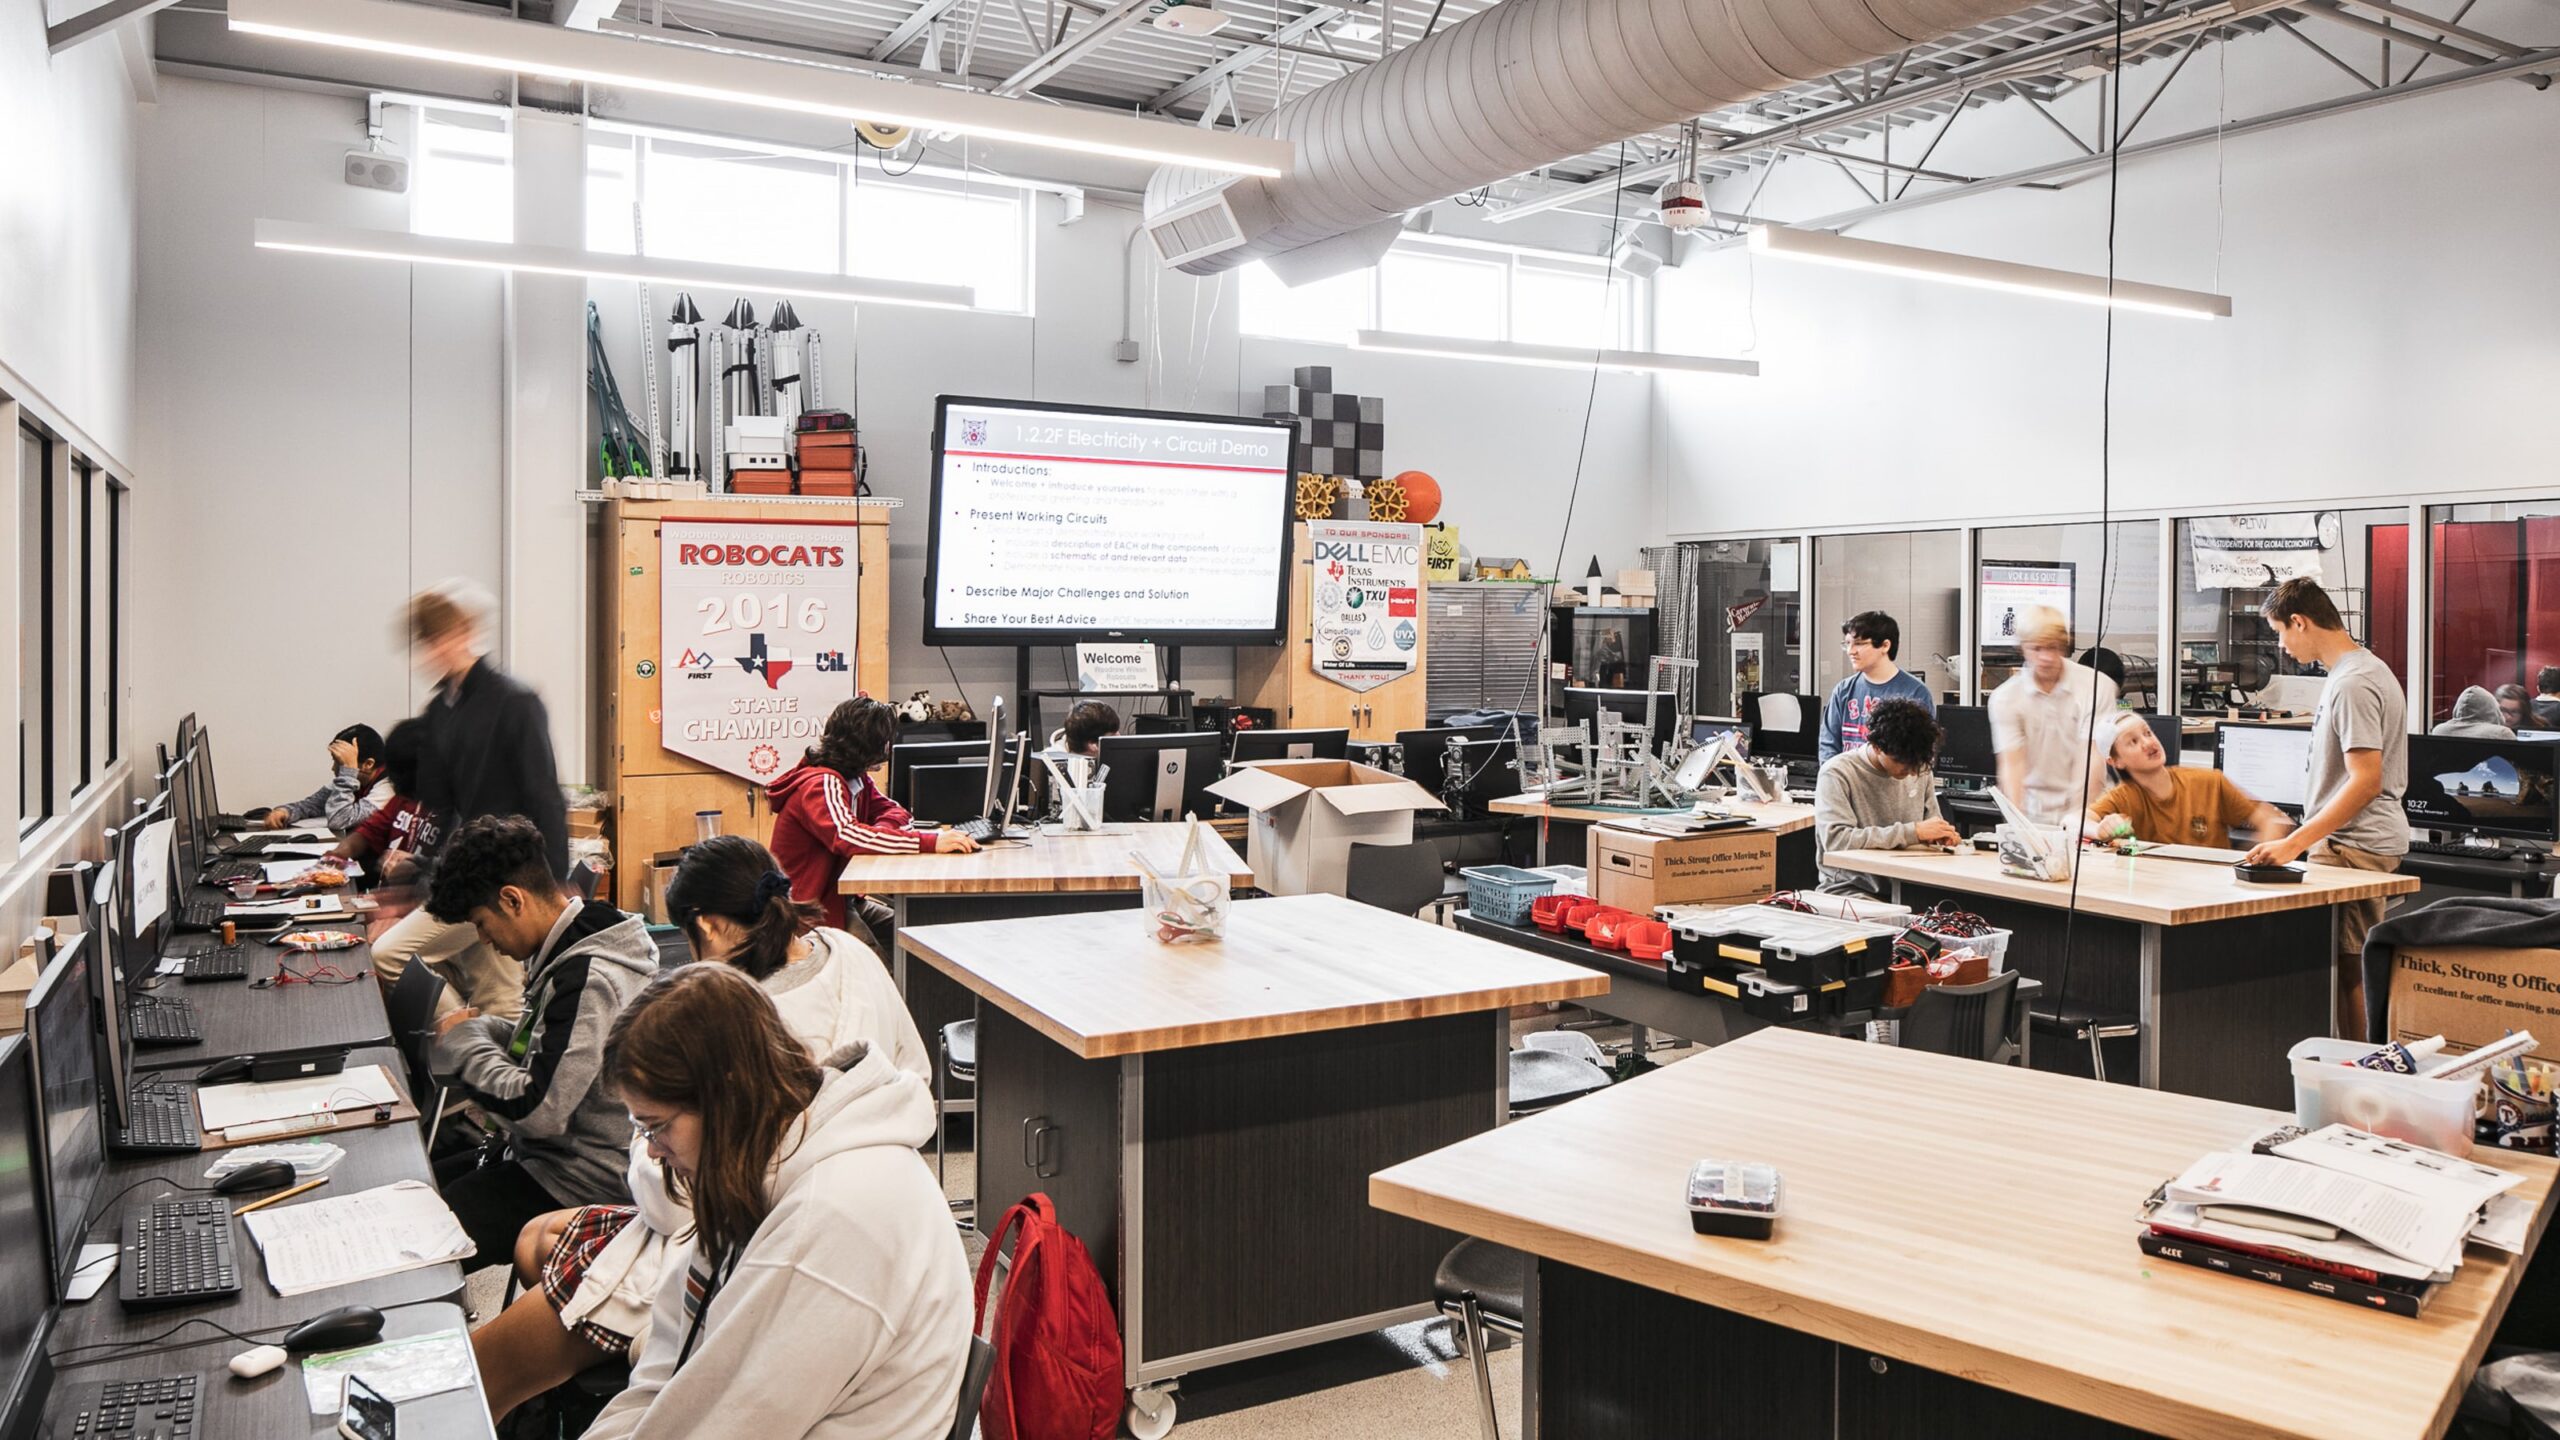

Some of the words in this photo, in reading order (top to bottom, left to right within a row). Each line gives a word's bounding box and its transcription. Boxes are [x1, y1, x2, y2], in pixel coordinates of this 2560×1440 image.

[1016, 424, 1064, 444] 1.2.2F
[1067, 428, 1148, 453] Electricity
[1166, 434, 1217, 454] Circuit
[1221, 439, 1270, 457] Demo
[970, 508, 1013, 520] Present
[1016, 510, 1064, 524] Working
[1066, 512, 1109, 524] Circuits
[1324, 528, 1336, 536] TO
[1340, 529, 1358, 537] OUR
[1051, 539, 1101, 550] description
[1115, 541, 1139, 549] EACH
[1167, 544, 1220, 554] components
[1315, 541, 1369, 563] DELL
[1371, 545, 1418, 566] EMC
[679, 543, 844, 567] ROBOCATS
[1050, 552, 1097, 561] schematic
[1130, 554, 1167, 562] relevant
[1168, 555, 1188, 563] data
[1427, 557, 1455, 569] FIRST
[721, 571, 806, 585] ROBOTICS
[965, 585, 1018, 596] Describe
[1020, 587, 1054, 599] Major
[1057, 587, 1121, 600] Challenges
[1124, 588, 1145, 598] and
[1148, 588, 1190, 599] Solution
[1365, 590, 1387, 600] TXU
[697, 591, 829, 636] 2016
[964, 612, 998, 623] Share
[1001, 613, 1028, 623] Your
[1030, 613, 1054, 623] Best
[1056, 614, 1097, 624] Advice
[1340, 613, 1362, 621] DALLAS
[1394, 630, 1415, 639] UVX
[1083, 652, 1142, 663] Welcome
[688, 672, 713, 680] FIRST
[729, 696, 799, 715] STATE
[2407, 799, 2428, 808] 10:27
[1688, 855, 1711, 866] Strong
[1712, 853, 1732, 862] Office
[1733, 851, 1758, 860] Moving
[1759, 849, 1772, 858] Box
[2398, 953, 2447, 979] Thick,
[2450, 962, 2508, 989] Strong
[2413, 982, 2458, 999] (Excellent
[2460, 990, 2475, 1000] for
[2476, 992, 2503, 1006] office
[2504, 999, 2545, 1014] moving,
